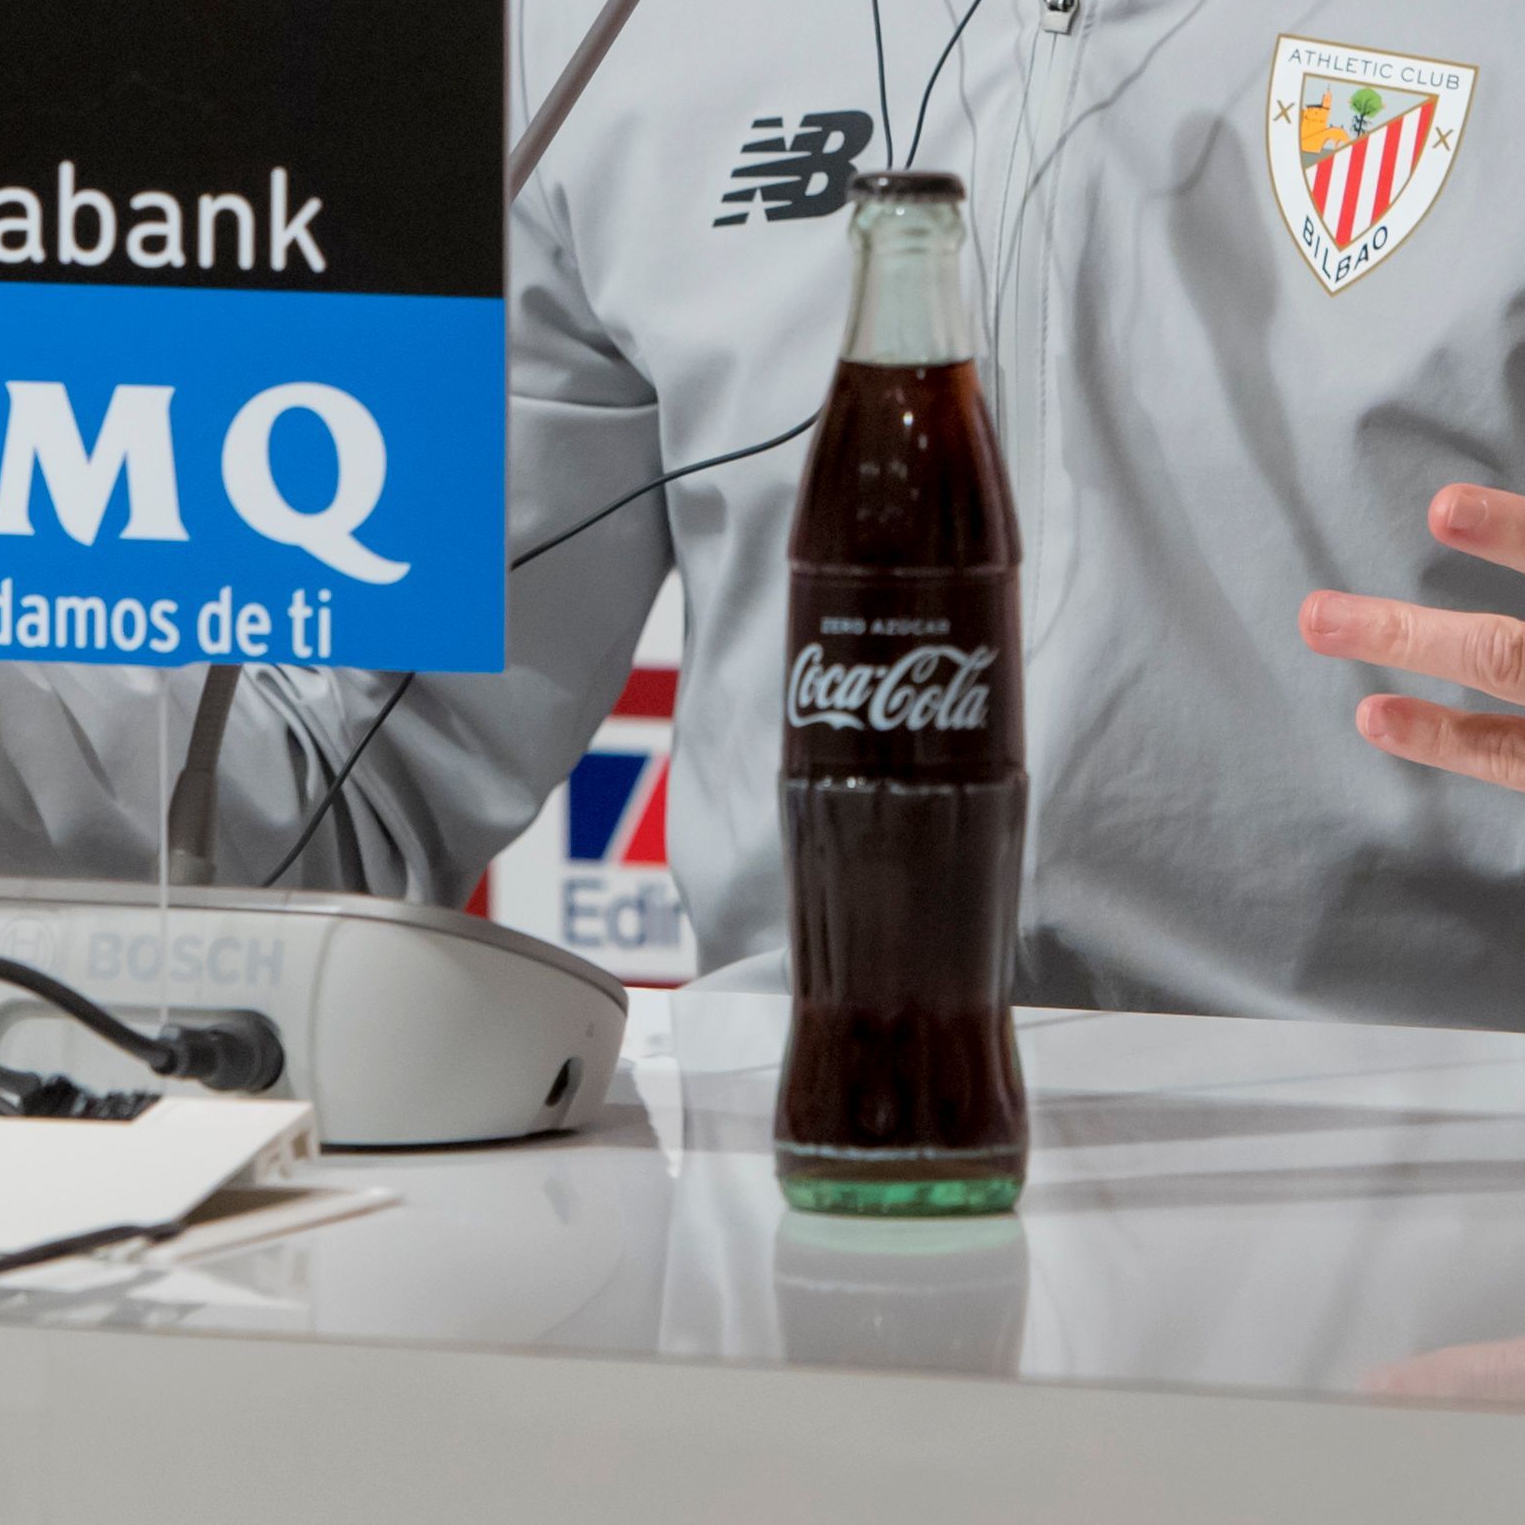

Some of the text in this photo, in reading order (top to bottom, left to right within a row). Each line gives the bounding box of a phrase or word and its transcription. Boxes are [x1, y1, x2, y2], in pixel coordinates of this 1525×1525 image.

[1288, 48, 1460, 90] ATHLETIC CLUB
[1302, 215, 1389, 283] BILBAO
[191, 585, 275, 656] de
[285, 586, 332, 659] ti
[788, 642, 999, 731] Coca-Cola
[561, 877, 681, 948] Edi
[87, 931, 284, 986] BOSCH
